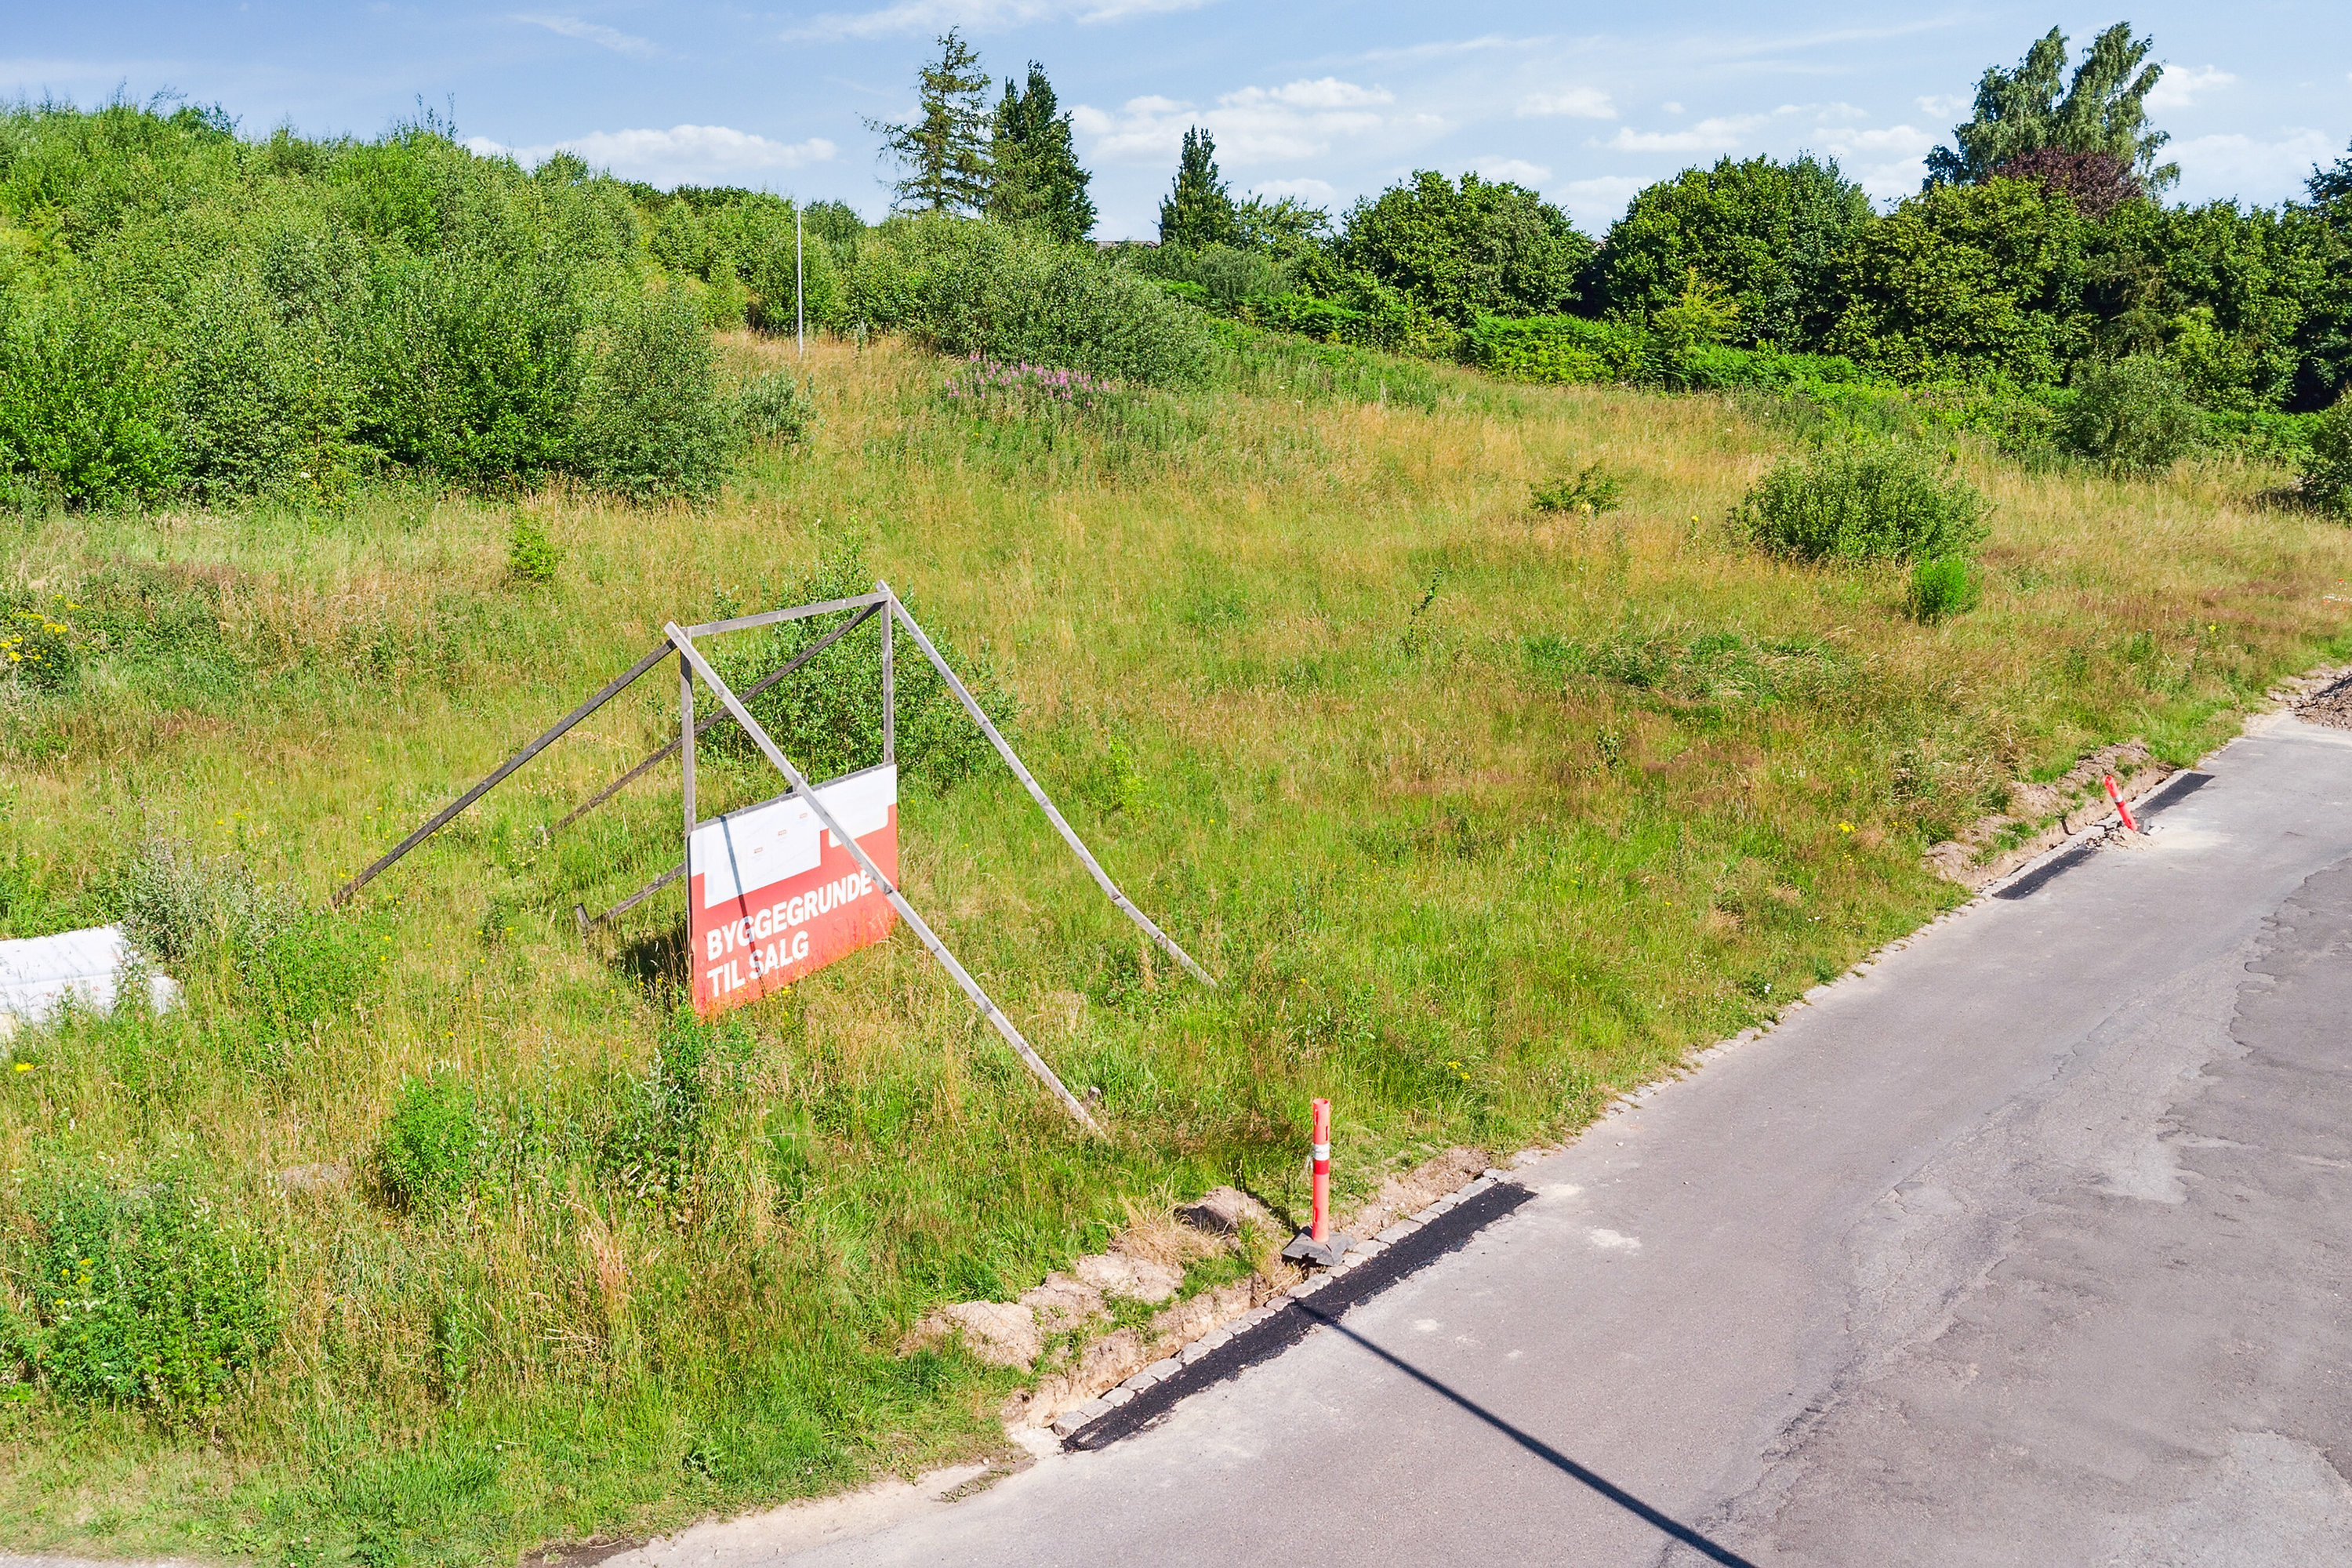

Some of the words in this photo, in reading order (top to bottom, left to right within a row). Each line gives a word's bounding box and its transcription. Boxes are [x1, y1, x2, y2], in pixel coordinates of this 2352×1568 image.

[707, 869, 873, 961] BYGGEGRUNDE
[706, 960, 745, 997] TIL
[749, 931, 809, 979] SALG
